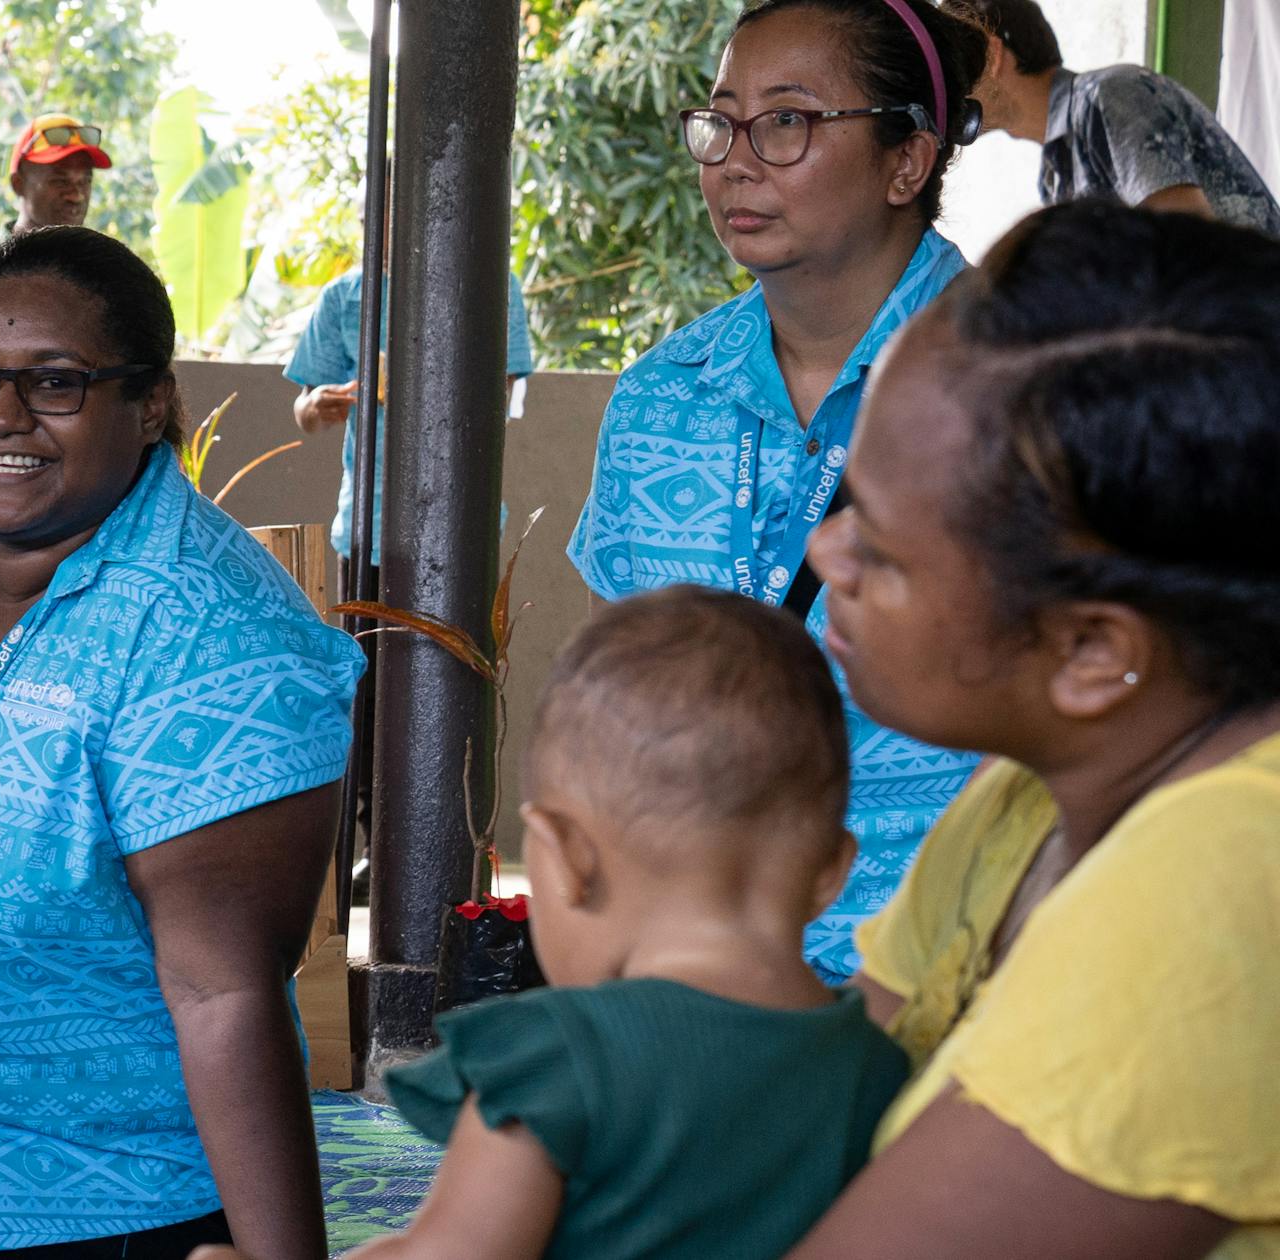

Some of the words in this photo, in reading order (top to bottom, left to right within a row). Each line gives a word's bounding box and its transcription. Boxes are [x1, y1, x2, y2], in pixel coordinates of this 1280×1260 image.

[737, 431, 755, 486] unicef
[803, 464, 839, 523] unicef
[734, 556, 757, 600] unic
[7, 677, 52, 701] unicef
